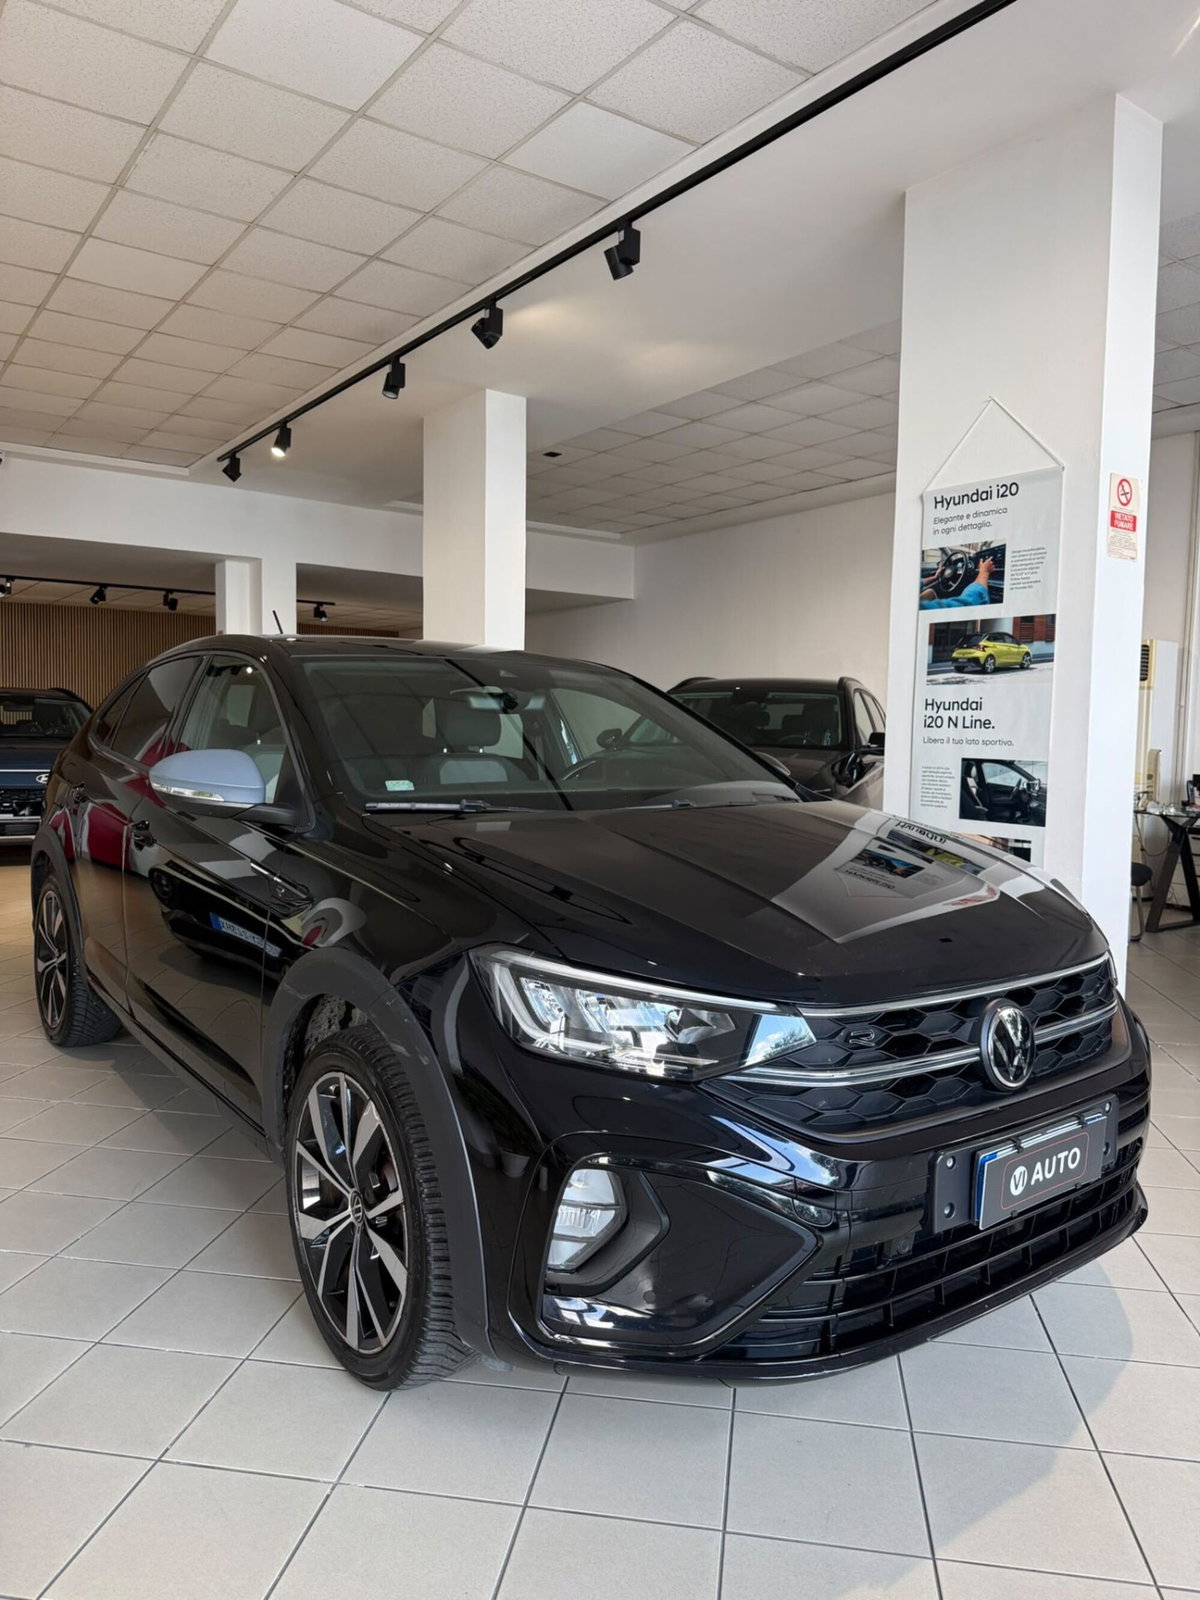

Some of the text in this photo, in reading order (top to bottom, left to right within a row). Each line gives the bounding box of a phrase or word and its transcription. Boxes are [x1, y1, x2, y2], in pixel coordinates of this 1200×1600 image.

[934, 482, 1019, 510] Hyundai i20
[933, 513, 964, 525] Elegante
[972, 507, 1008, 519] dinamica
[941, 526, 956, 535] ogni
[958, 520, 992, 531] dettaglio.
[924, 697, 983, 714] Hyundai
[923, 715, 995, 729] i20 N Line.
[922, 736, 1014, 747] Libera il tuo lato sportivo.
[1031, 1147, 1081, 1185] AUTO
